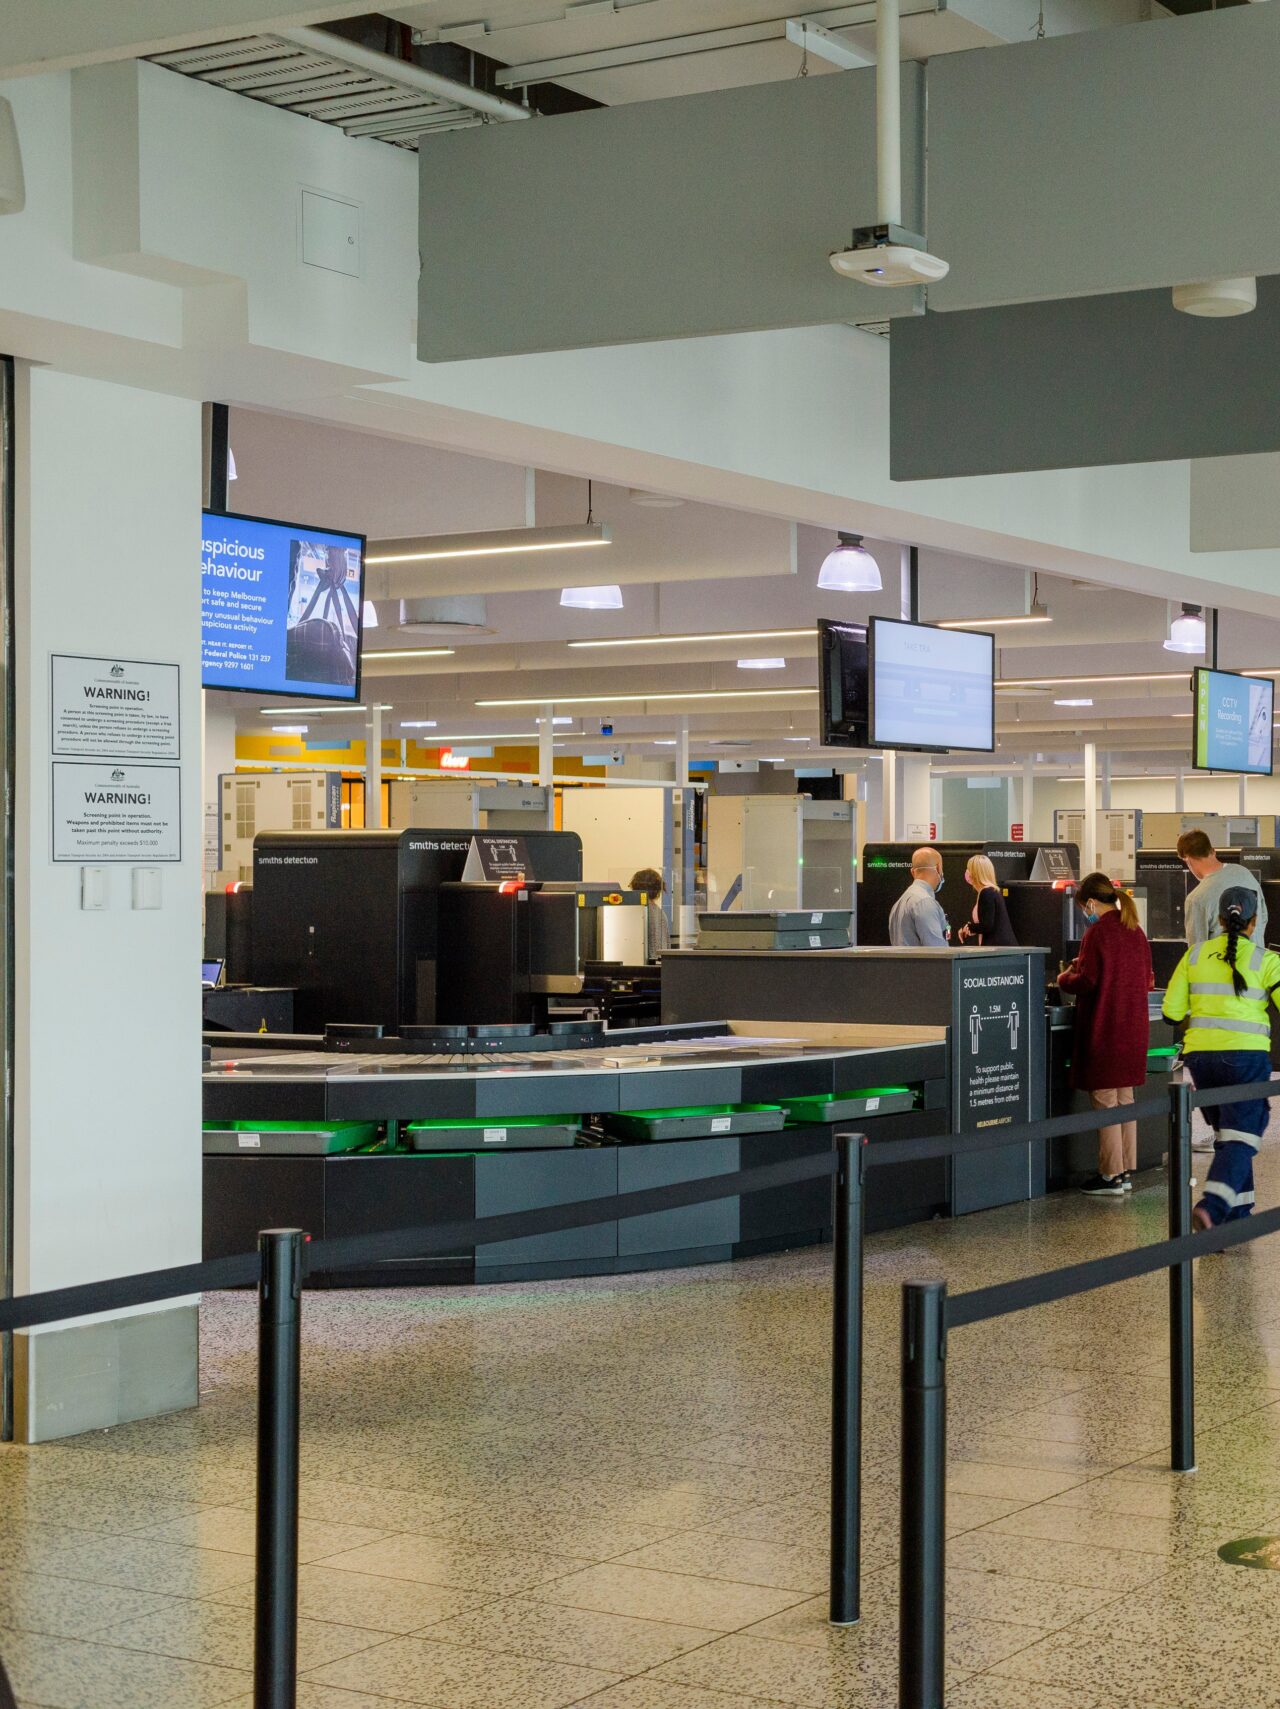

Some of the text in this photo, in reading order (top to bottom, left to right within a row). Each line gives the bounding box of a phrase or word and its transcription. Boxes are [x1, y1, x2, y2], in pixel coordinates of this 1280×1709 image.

[213, 588, 229, 598] keep
[231, 591, 266, 603] Melbourne
[211, 598, 225, 606] safe
[241, 603, 261, 611] secure
[242, 614, 273, 624] behaviour
[234, 624, 257, 634] activity
[204, 649, 227, 657] Federal
[229, 652, 246, 660] Police
[224, 661, 238, 669] 9297
[84, 686, 150, 701] WARNING!
[1222, 697, 1238, 708] CCTV
[1217, 710, 1242, 724] Recording
[85, 792, 151, 804] WARNING!
[409, 842, 439, 850] smiths
[964, 975, 1024, 988] SOCIAL DISTANCING
[989, 1005, 1001, 1013] 1.5M
[982, 1065, 999, 1074] support
[1000, 1062, 1014, 1073] public
[970, 1072, 1019, 1085] health please maintain
[996, 1085, 1013, 1093] distance
[1014, 1081, 1019, 1090] of
[978, 1098, 993, 1106] metres
[1006, 1094, 1019, 1102] others
